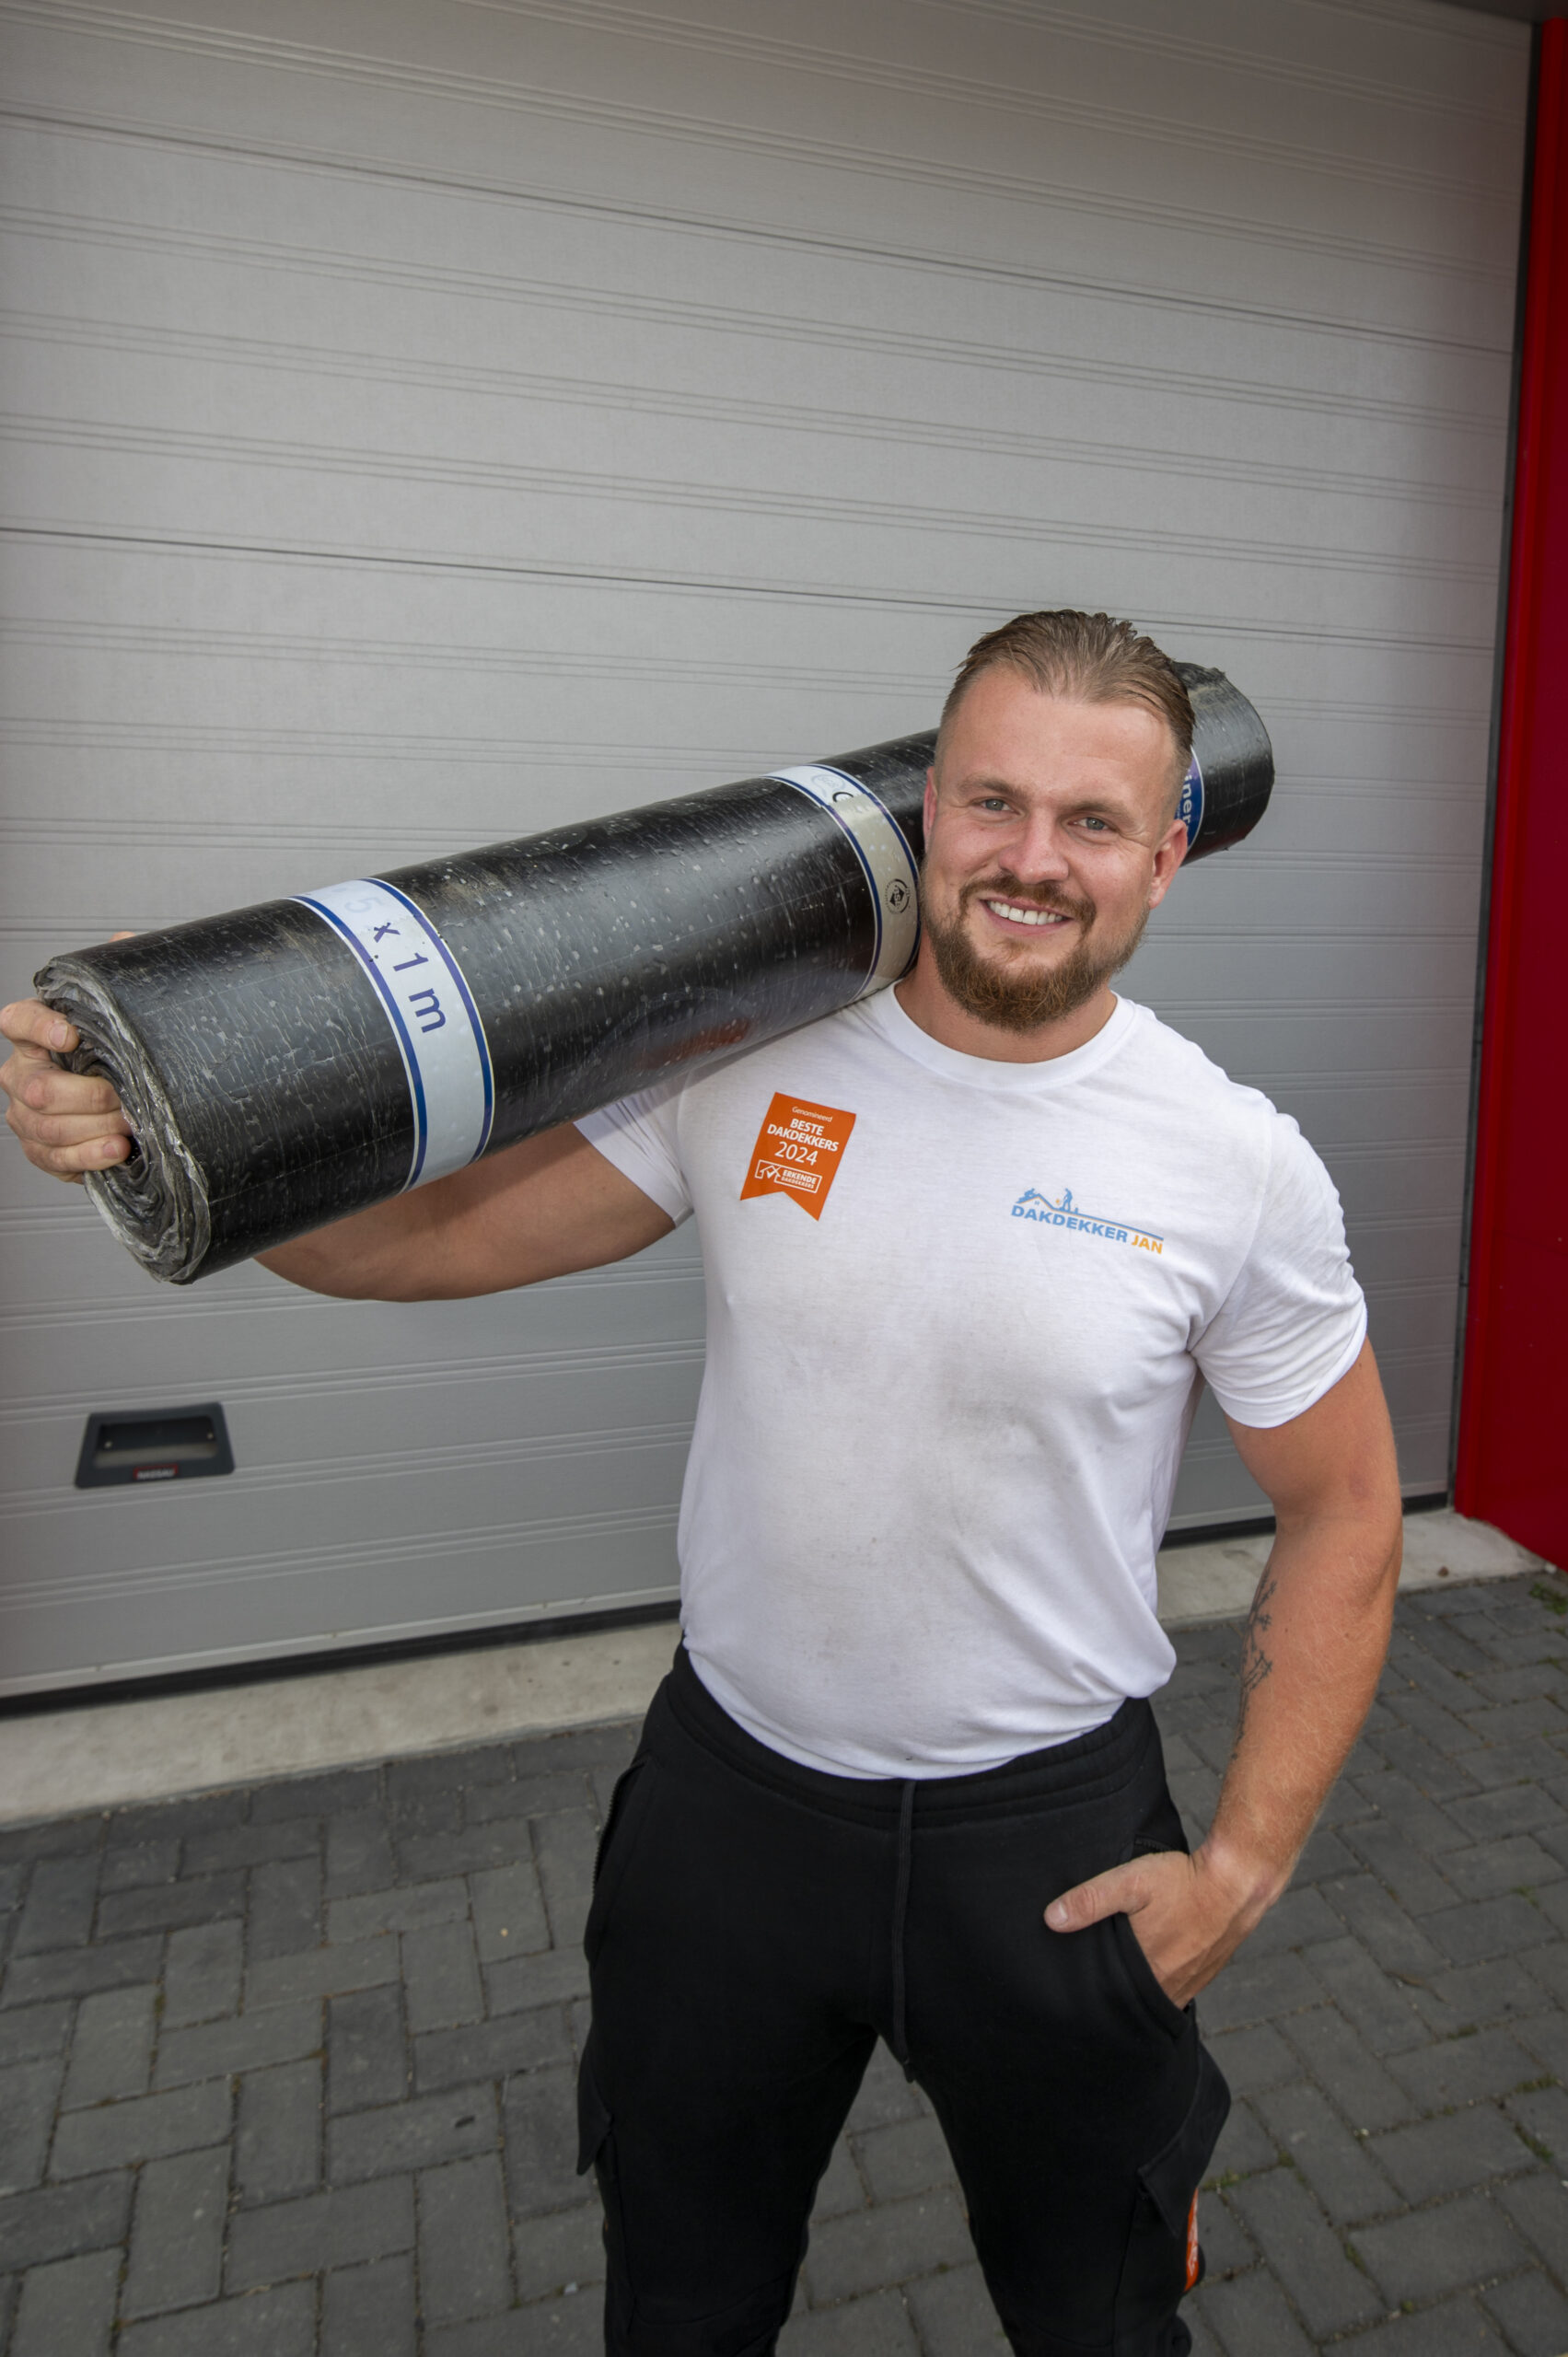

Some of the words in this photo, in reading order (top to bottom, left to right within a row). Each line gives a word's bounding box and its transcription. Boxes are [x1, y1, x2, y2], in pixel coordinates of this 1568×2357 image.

[373, 922, 401, 943] x
[392, 952, 429, 972] 1
[408, 988, 447, 1033] m
[792, 1106, 832, 1122] Genomineerd
[767, 1123, 840, 1152] DAKDEKKERS
[790, 1118, 824, 1136] BESTE
[774, 1141, 819, 1167] 2024
[782, 1169, 818, 1185] ERKENDE
[1011, 1204, 1128, 1243] DAKDEKKER
[1131, 1235, 1163, 1255] JAN
